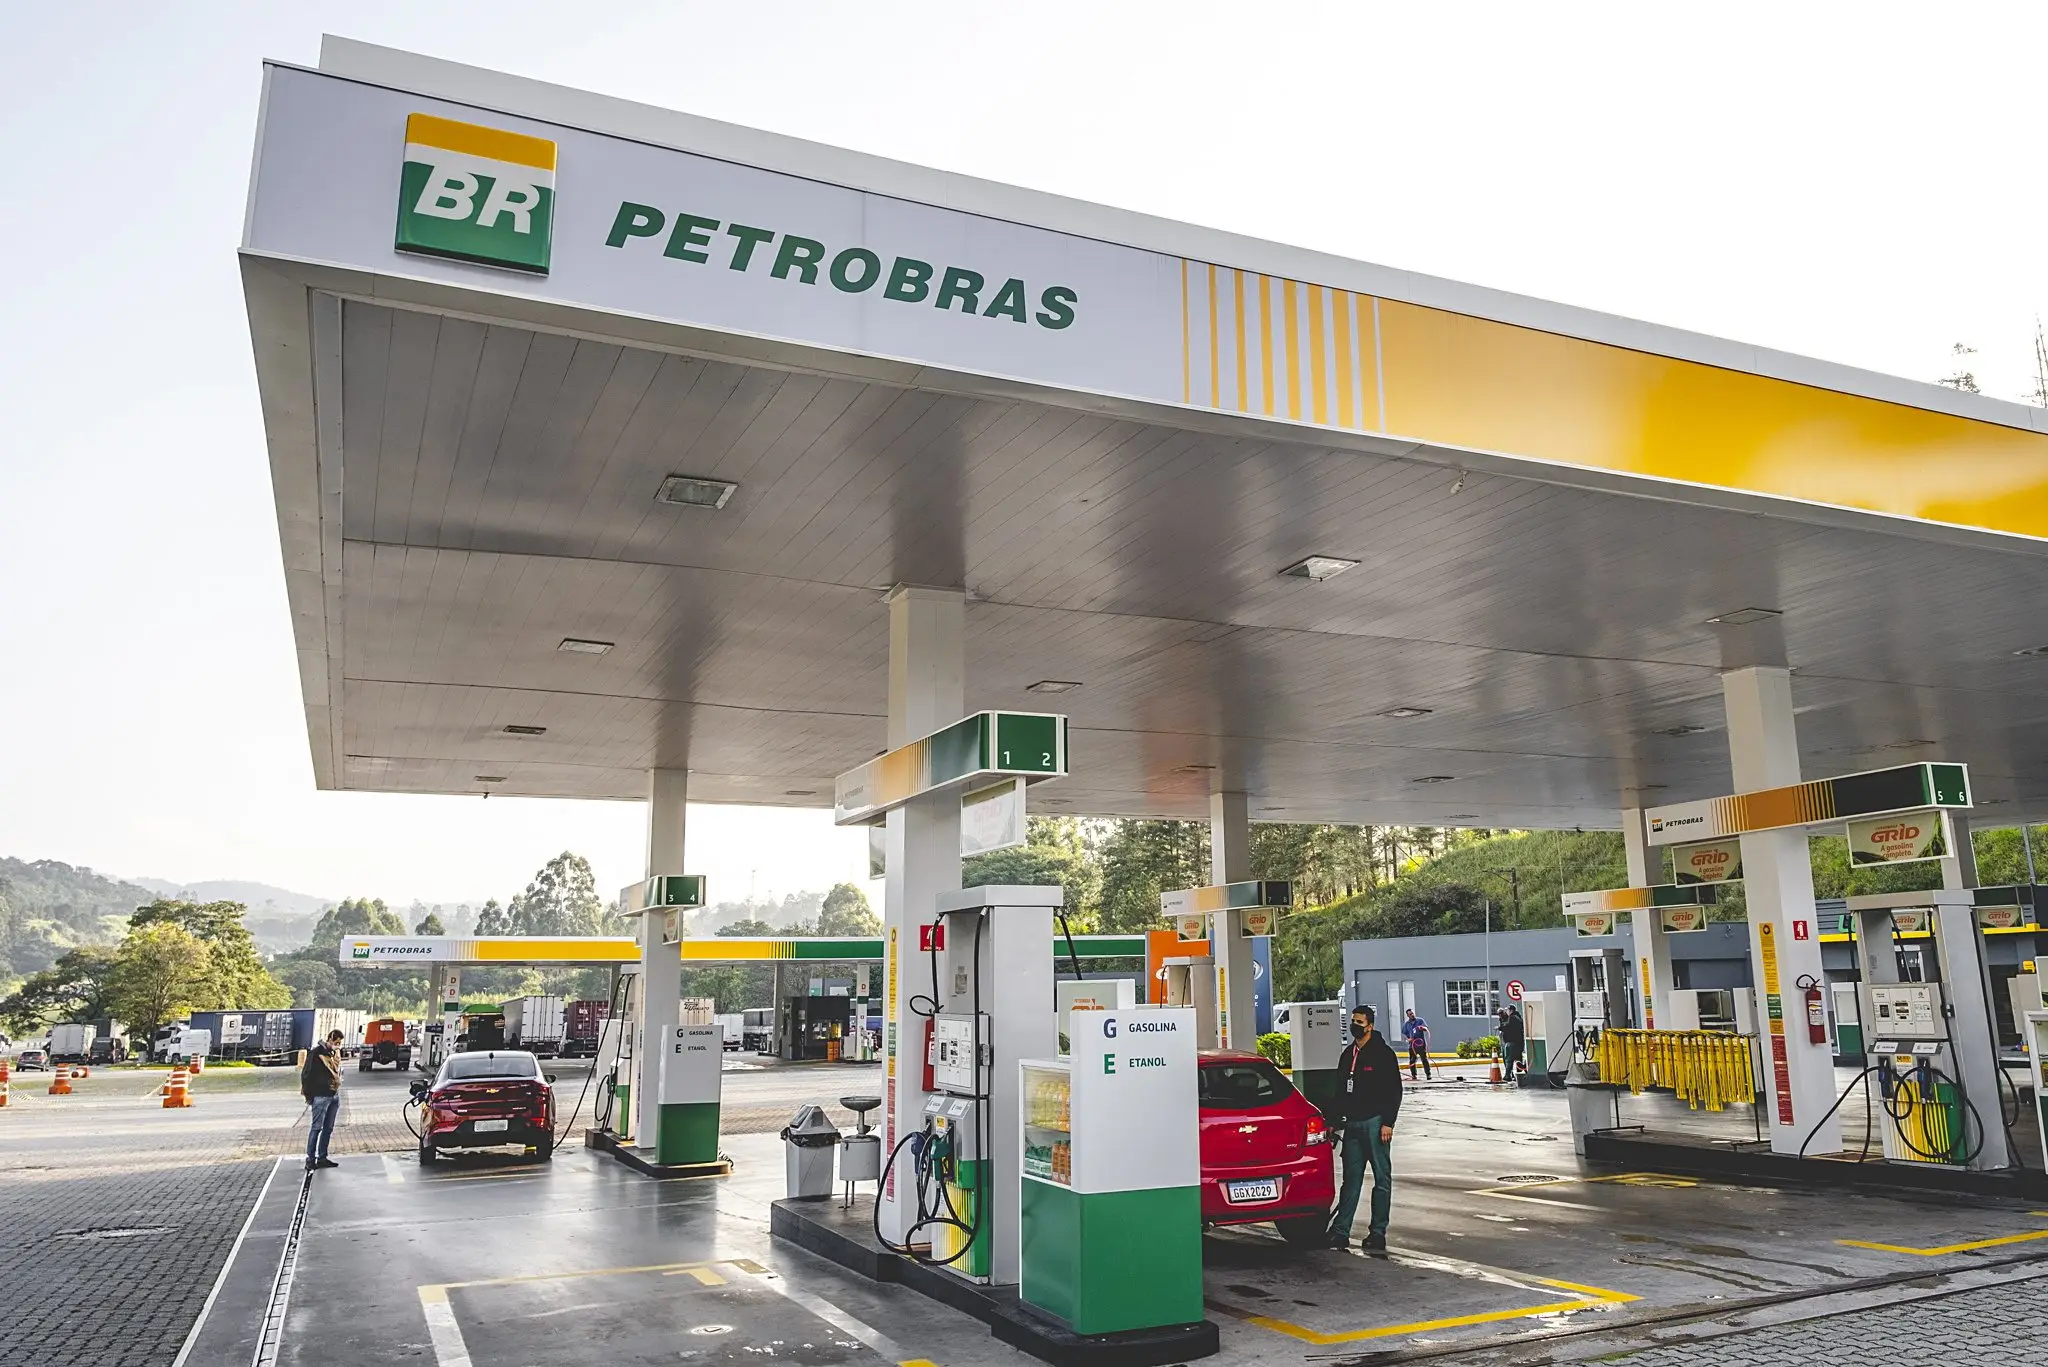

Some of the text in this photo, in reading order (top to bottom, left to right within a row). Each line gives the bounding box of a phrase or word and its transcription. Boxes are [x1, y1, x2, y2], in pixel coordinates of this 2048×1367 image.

[413, 163, 1078, 330] BR PETROBRAS
[1003, 751, 1051, 767] 1 2
[1937, 790, 1965, 802] 5 6
[1665, 816, 1704, 828] PETROBRAS
[1870, 823, 1920, 843] GRID
[1886, 842, 1914, 853] gasolina
[1691, 848, 1729, 866] GRID
[668, 894, 696, 902] 3 4
[1268, 896, 1273, 904] 7
[1249, 914, 1267, 925] GRID
[1671, 911, 1694, 922] GRID
[1988, 911, 2011, 920] GRID
[1585, 917, 1605, 926] GRID
[1307, 1007, 1313, 1016] G
[229, 1020, 235, 1028] E
[1103, 1018, 1177, 1039] G GASOLINA
[1308, 1020, 1312, 1028] E
[676, 1028, 684, 1038] G
[675, 1044, 682, 1054] E
[1104, 1053, 1167, 1075] E ETANOL
[1233, 1186, 1272, 1199] GGX2C29
